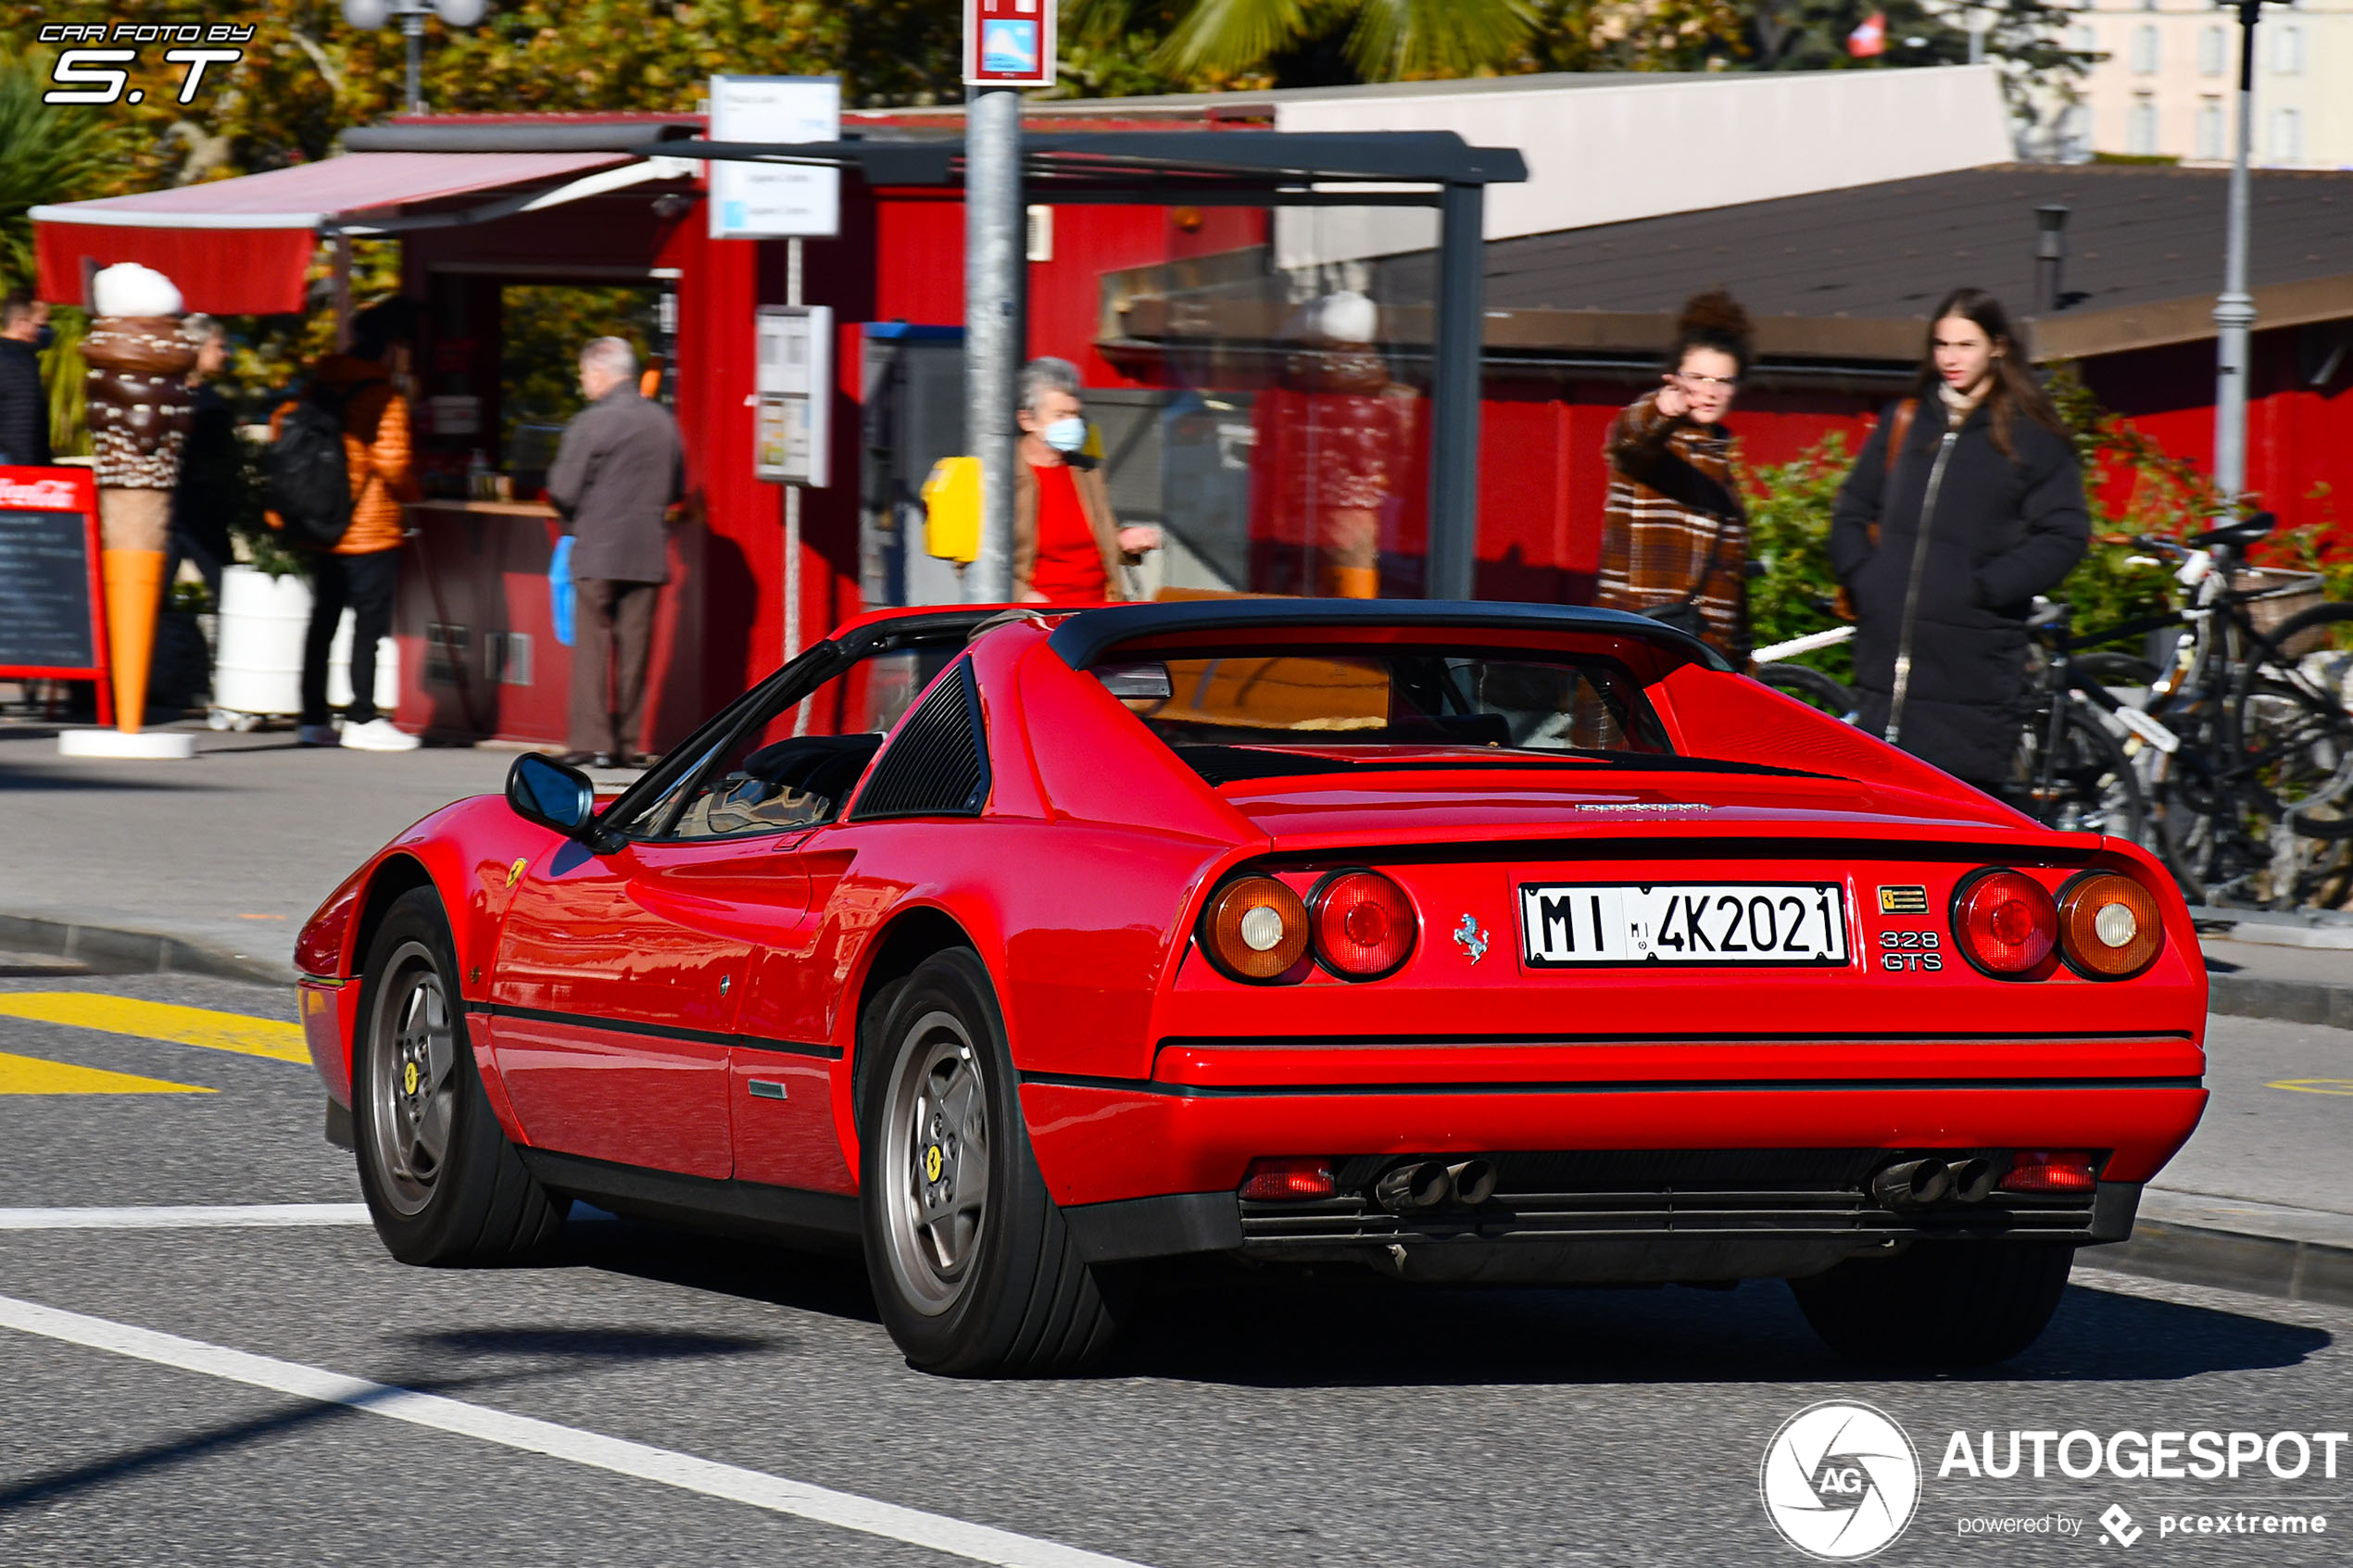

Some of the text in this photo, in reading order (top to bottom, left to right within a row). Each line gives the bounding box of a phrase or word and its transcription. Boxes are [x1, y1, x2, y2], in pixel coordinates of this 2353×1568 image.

[1540, 896, 1604, 952] MI
[1657, 896, 1833, 953] 4K2021
[1879, 931, 1940, 949] 328
[1881, 952, 1944, 972] GTS
